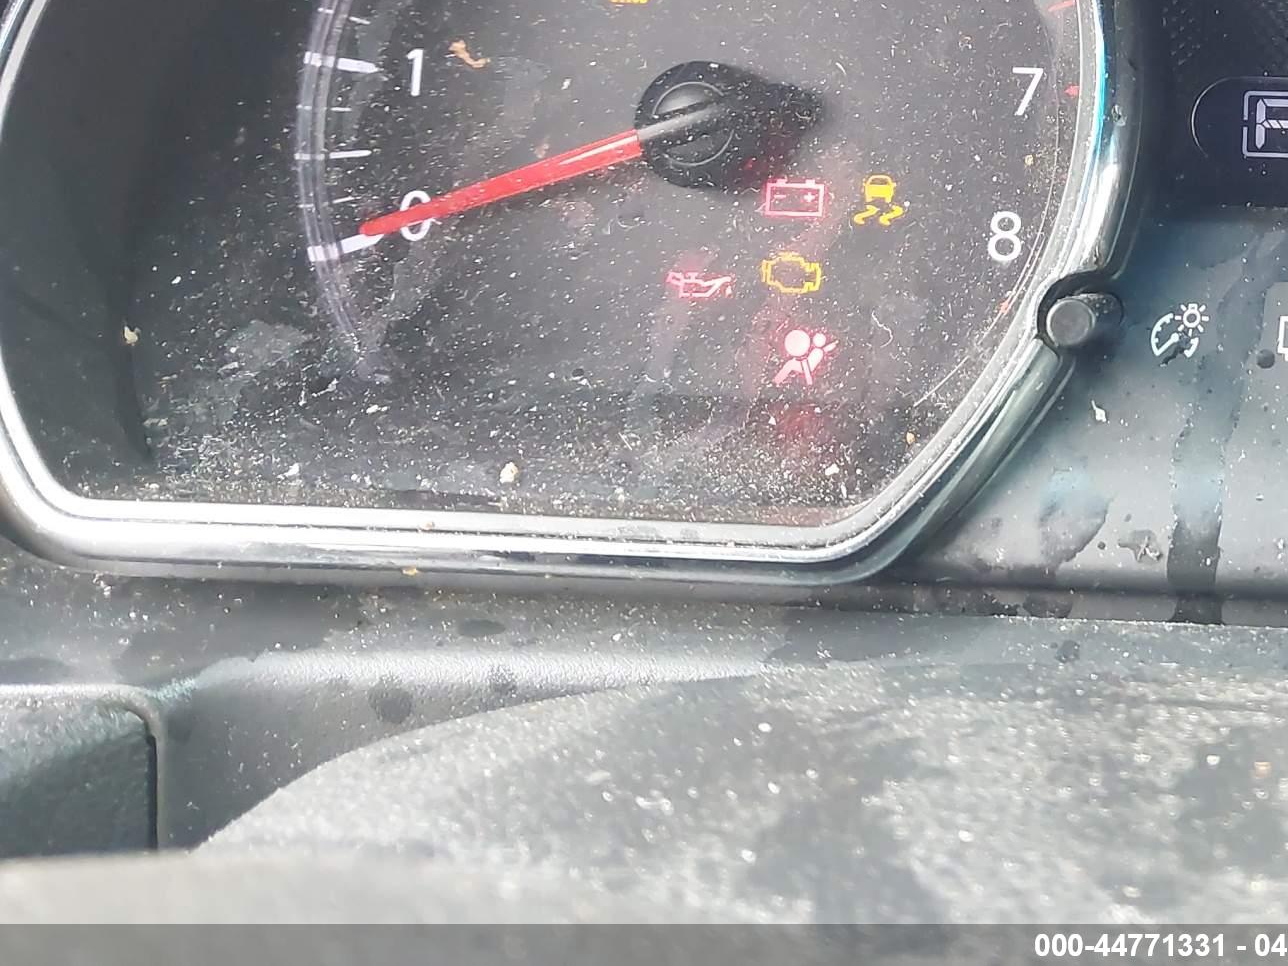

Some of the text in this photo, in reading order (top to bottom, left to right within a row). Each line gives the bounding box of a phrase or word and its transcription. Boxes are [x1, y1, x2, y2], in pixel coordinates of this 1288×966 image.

[406, 48, 424, 96] 1
[1012, 66, 1045, 116] 7
[400, 190, 432, 241] 0
[988, 211, 1023, 261] 8
